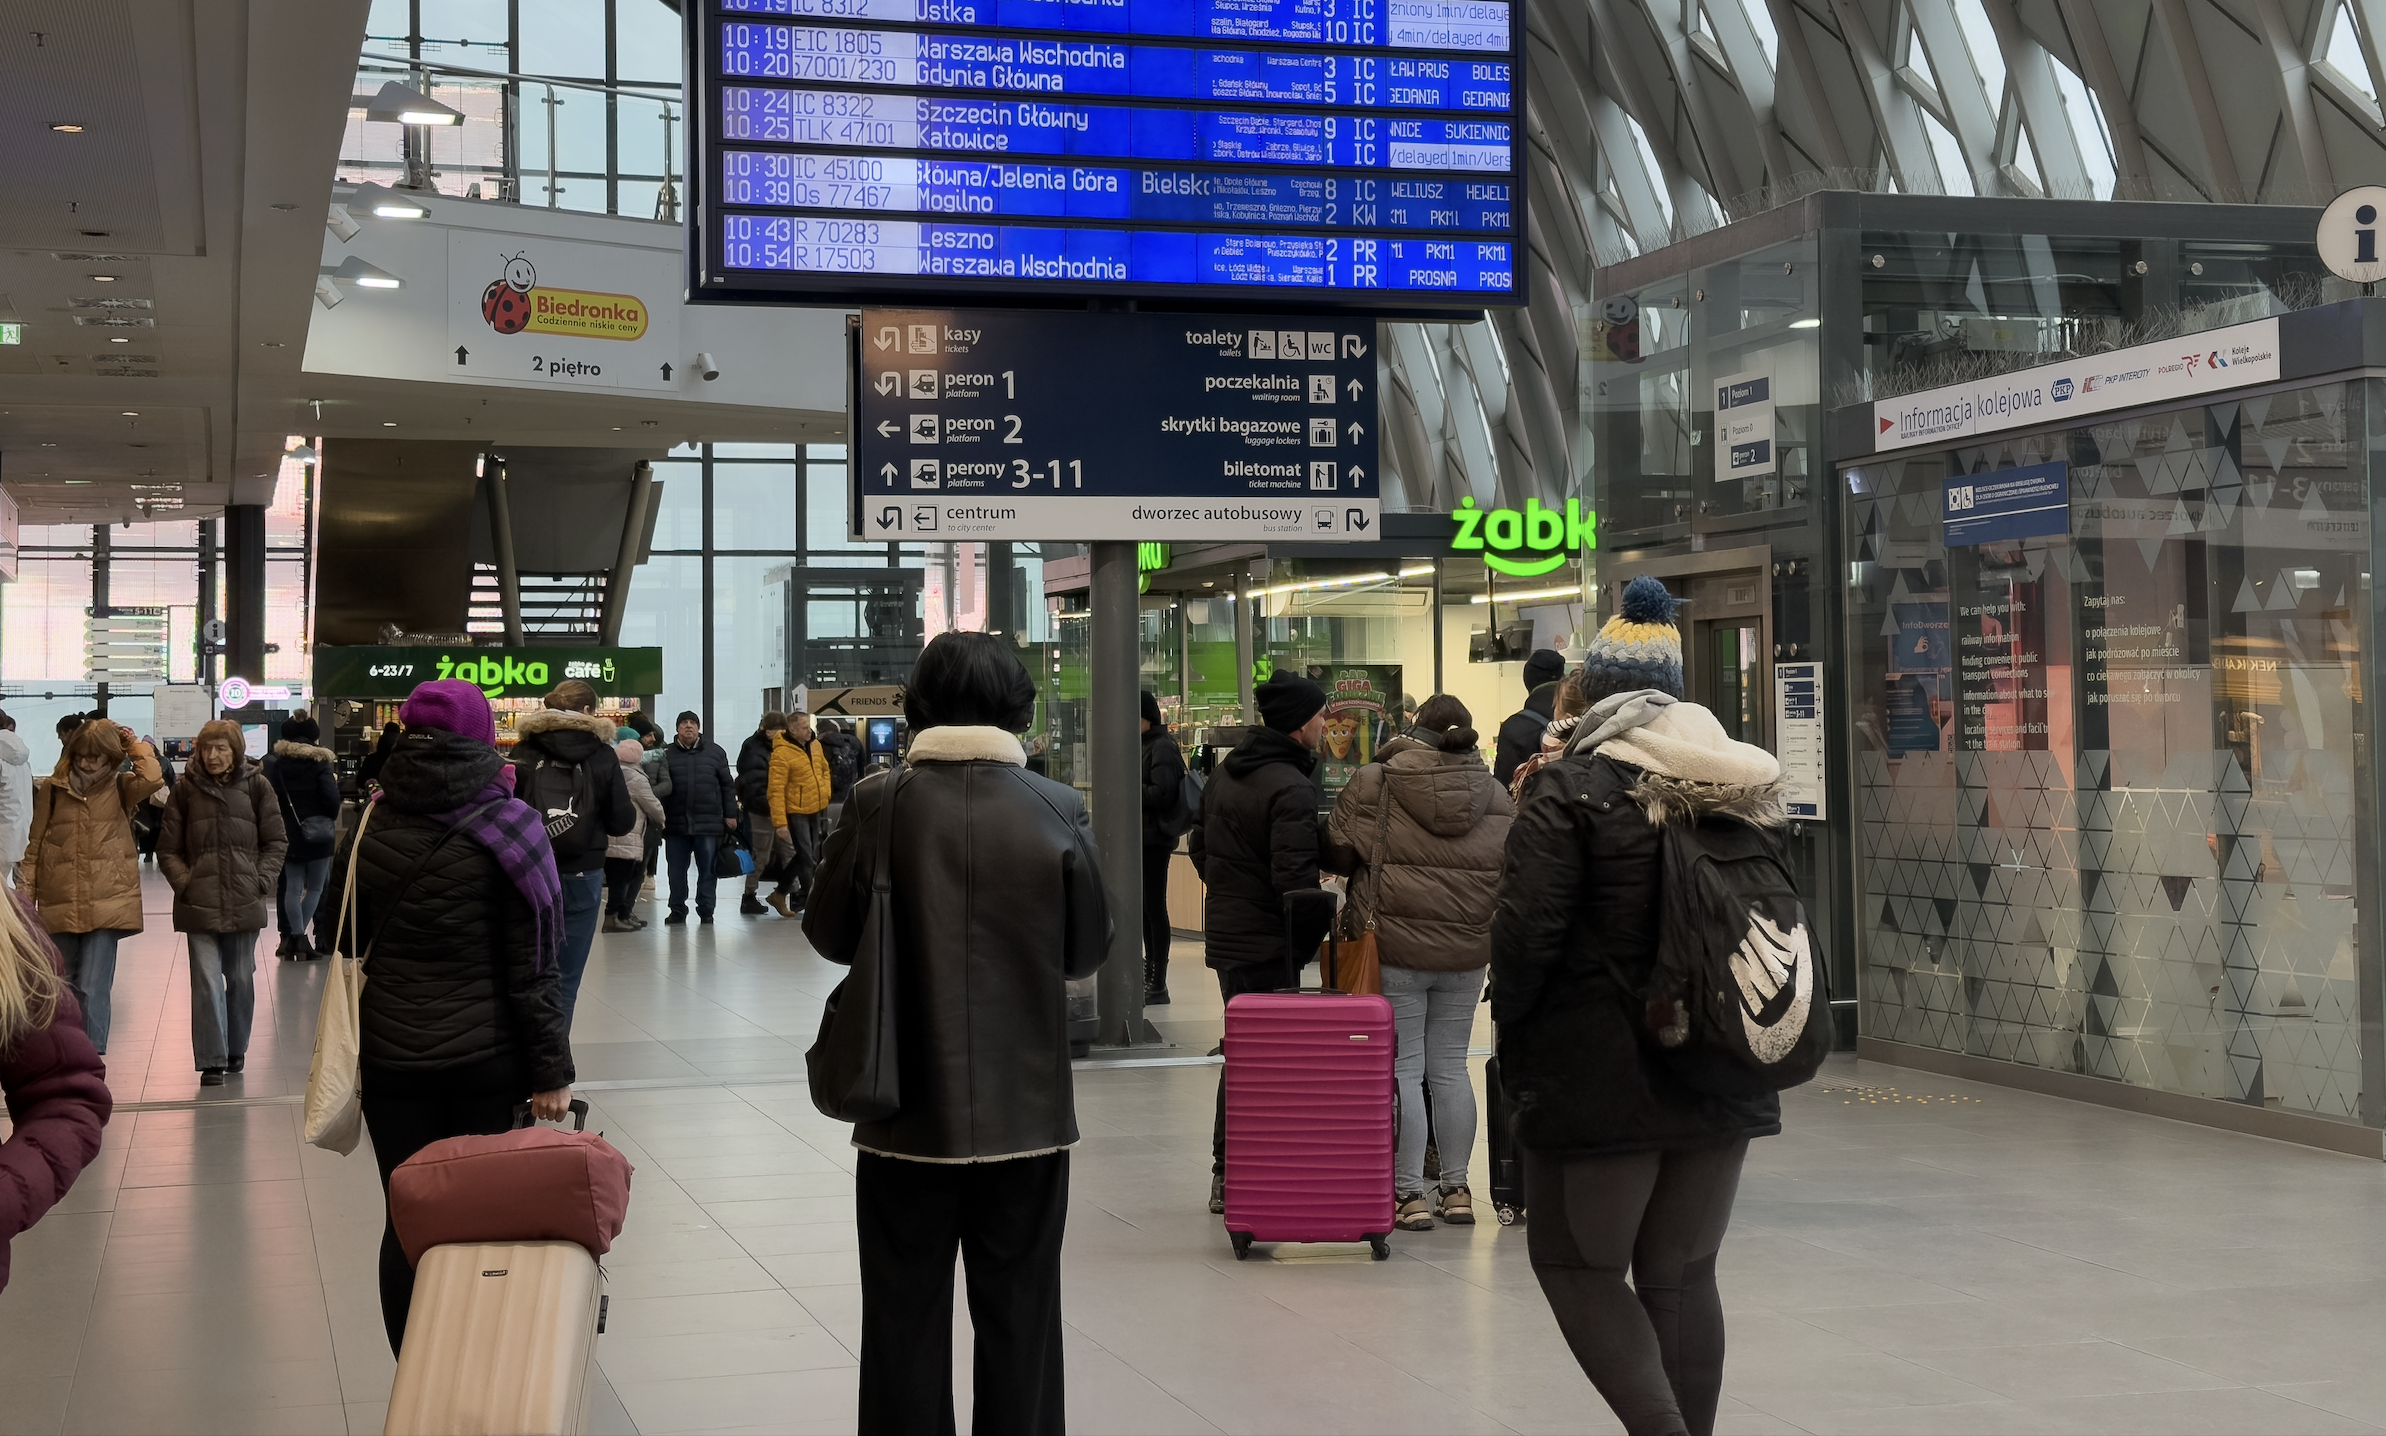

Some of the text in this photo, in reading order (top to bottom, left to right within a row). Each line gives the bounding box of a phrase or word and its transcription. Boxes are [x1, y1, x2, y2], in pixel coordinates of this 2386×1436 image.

[916, 0, 976, 23] Ustka
[725, 24, 788, 50] 10:19
[794, 29, 882, 55] EIC 1805
[1325, 21, 1349, 43] 10
[1353, 23, 1377, 45] IC
[1397, 28, 1482, 46] 4min/delayed
[917, 35, 1126, 69] Warszawa Wschodnia
[725, 50, 789, 76] 10:20
[1324, 57, 1337, 79] 3
[1354, 58, 1377, 80] IC
[1418, 62, 1450, 79] PRUS
[1472, 65, 1510, 81] BOLES
[917, 61, 1063, 91] Gdynia Główna
[725, 89, 789, 114] 10:24
[1324, 82, 1337, 104] 5
[1354, 83, 1376, 105] IC
[794, 93, 874, 118] IC 8322
[917, 97, 1089, 131] Szczecin Główny
[725, 115, 790, 140] 10:25
[795, 121, 895, 145] TLK 47101
[917, 125, 1008, 150] Katowice
[1324, 118, 1337, 140] 9
[1354, 120, 1376, 141] IC
[1445, 124, 1510, 141] SUKIENNIC
[1326, 142, 1335, 164] 1
[1354, 144, 1377, 166] IC
[726, 153, 790, 178] 10:30
[796, 158, 883, 181] IC 45100
[1072, 168, 1118, 193] Góra
[1325, 178, 1337, 201] 8
[1391, 182, 1444, 199] WELIUSZ
[726, 179, 790, 204] 10:39
[795, 185, 891, 208] Os 77467
[1354, 180, 1377, 202] IC
[1466, 184, 1511, 201] HEWELI
[918, 192, 994, 213] Mogilno
[1325, 203, 1338, 225] 2
[1352, 204, 1377, 226] KW
[1481, 212, 1511, 228] PKM1
[727, 217, 791, 241] 10:43
[796, 222, 880, 245] R 70283
[919, 223, 994, 249] Leszno
[727, 243, 791, 268] 10:54
[796, 247, 875, 271] R 17503
[1326, 240, 1338, 262] 2
[1353, 240, 1377, 263] PR
[1426, 243, 1455, 260] PKM1
[1477, 245, 1506, 261] PKM1
[919, 250, 1127, 280] Warszawa Wschodnia
[1327, 264, 1336, 286] 1
[1353, 265, 1377, 287] PR
[1409, 270, 1457, 287] PROSNA
[536, 295, 639, 323] Biedronka
[536, 314, 639, 334] Codziennie niskie ceny
[944, 325, 982, 345] kasy
[1186, 329, 1242, 349] toalety
[944, 344, 969, 354] tickets
[1219, 348, 1242, 358] toilets
[1311, 343, 1332, 354] WC
[2231, 344, 2250, 356] Koleje
[2231, 351, 2272, 366] Wielkopolskie
[532, 355, 602, 378] 2 piętro
[2104, 368, 2151, 385] PKP INTERCITY
[945, 370, 1015, 400] peron 1
[1205, 374, 1300, 392] poczekalnia
[2054, 384, 2072, 396] PKP
[945, 389, 980, 399] platform
[1252, 393, 1301, 403] waiting room
[1731, 387, 1749, 400] Poziom
[1900, 387, 2042, 432] Informacja kolejowa
[945, 414, 1024, 444] peron 2
[1161, 416, 1216, 436] skrytki
[1732, 424, 1750, 436] Poziom
[1946, 422, 1961, 432] OFFICE
[946, 434, 981, 444] platform
[1244, 436, 1301, 447] luggage lockers
[946, 458, 1083, 489] perony 3-11
[1223, 460, 1302, 477] biletomat
[946, 479, 985, 488] platforms
[1248, 480, 1302, 489] ticket machine
[946, 506, 1016, 520] centrum
[1132, 505, 1303, 523] dworzec autobusowy
[947, 524, 996, 533] to city center
[1263, 524, 1303, 533] bus station
[2083, 593, 2126, 608] Zapytaj nas:
[1961, 630, 2020, 646] railway information
[2091, 624, 2162, 642] połączenia kolejowe
[1961, 650, 2038, 668] finding convenient public
[2097, 644, 2180, 661] podróżować mieście
[368, 664, 414, 677] 6-23/7
[435, 654, 549, 686] żabka
[564, 662, 602, 679] café
[1962, 669, 1990, 682] transport
[1990, 667, 2029, 680] connections
[2174, 667, 2201, 681] okolicy
[1335, 679, 1372, 692] GIGA
[1963, 687, 2034, 701] information about what
[851, 697, 887, 706] FRIENDS
[2153, 690, 2181, 703] dworcu
